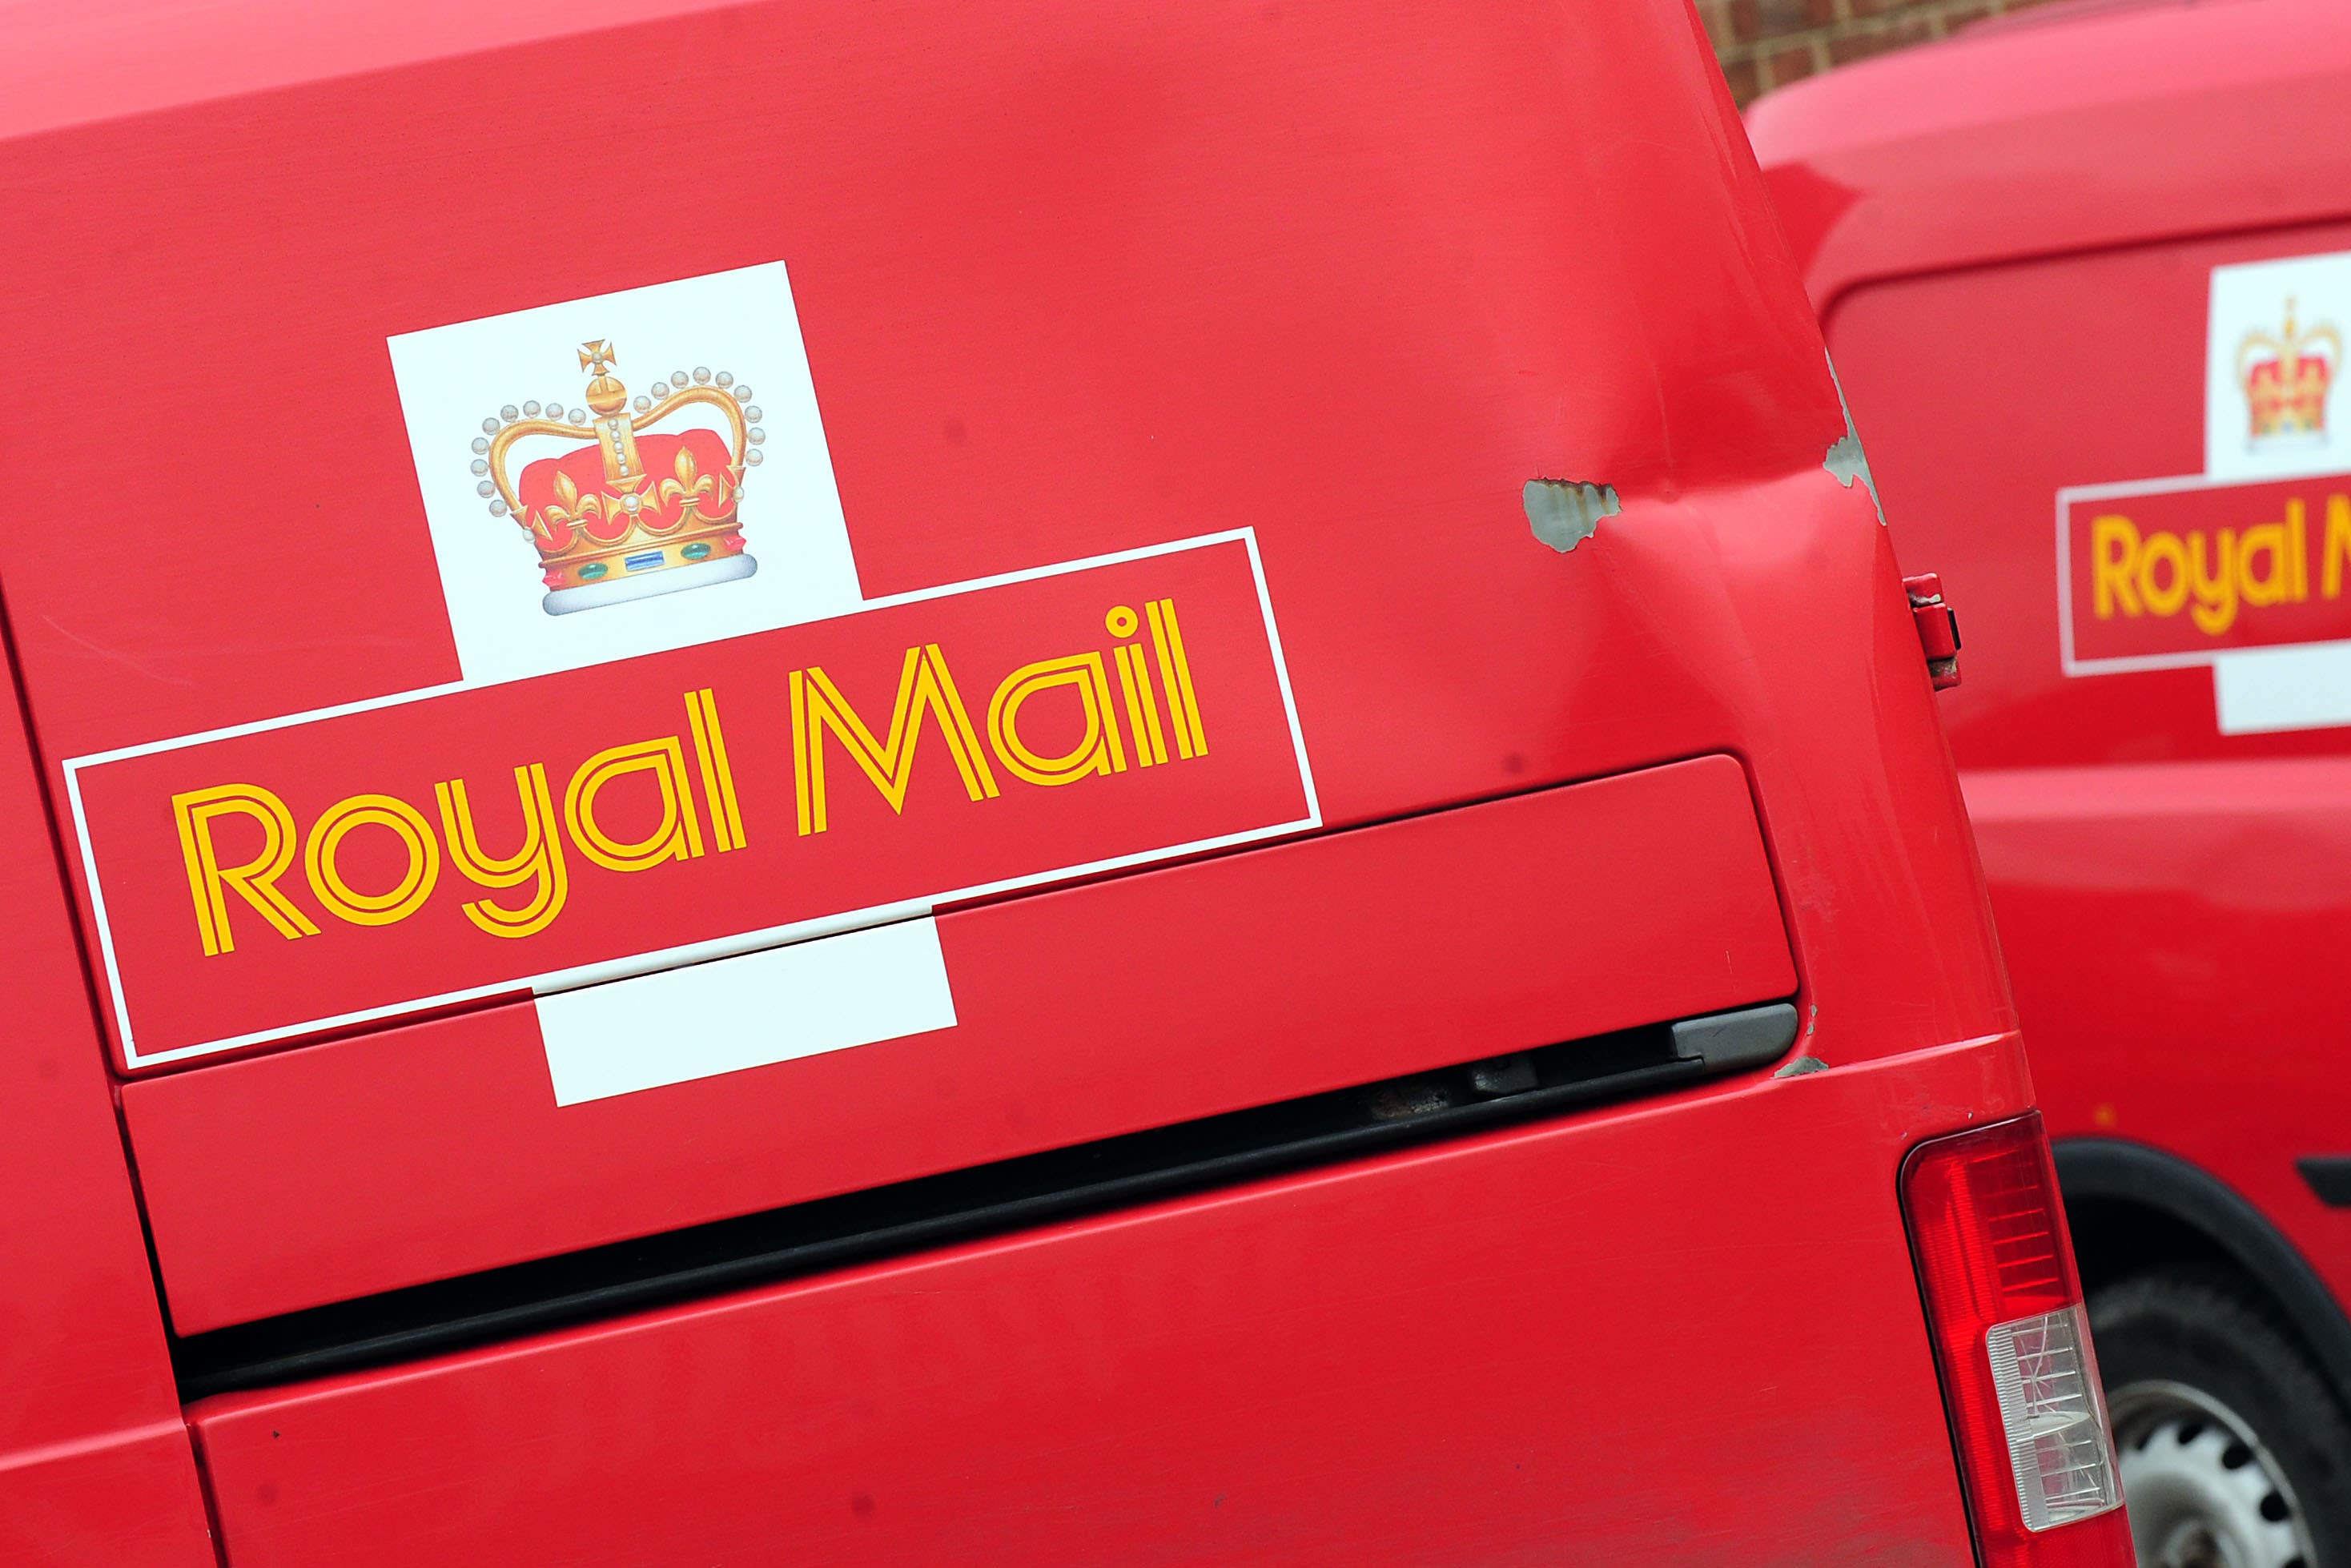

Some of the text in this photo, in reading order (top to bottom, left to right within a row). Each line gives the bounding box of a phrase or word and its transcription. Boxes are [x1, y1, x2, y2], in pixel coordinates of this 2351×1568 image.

[2092, 498, 2308, 636] Royal
[171, 598, 1209, 956] Royal Mail
